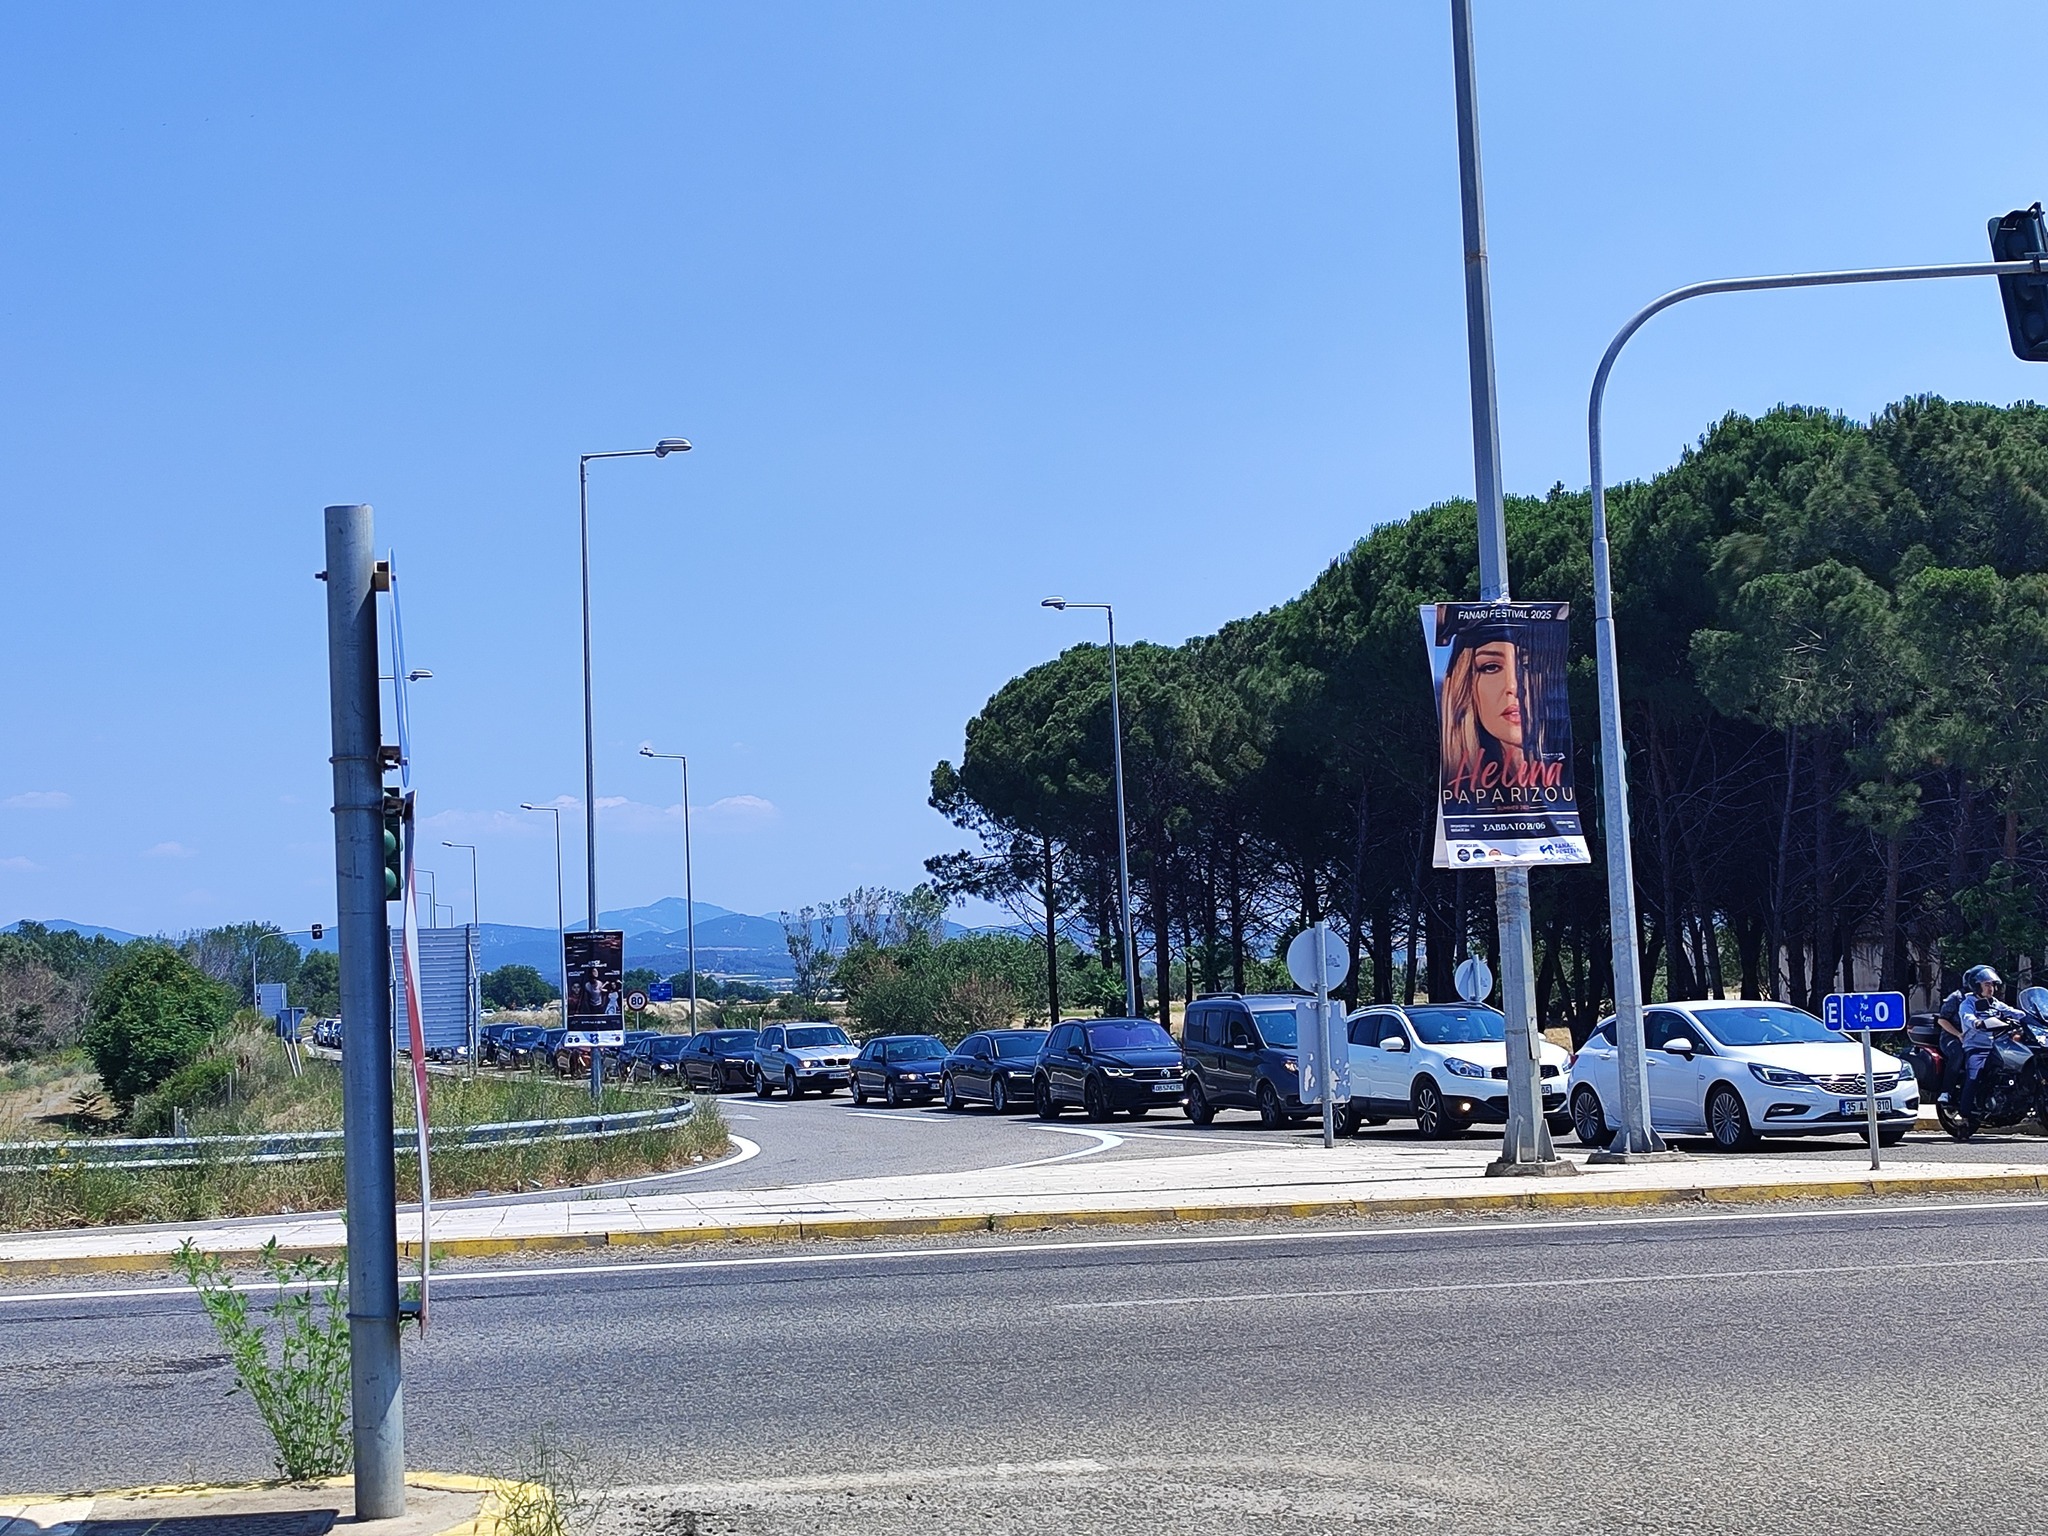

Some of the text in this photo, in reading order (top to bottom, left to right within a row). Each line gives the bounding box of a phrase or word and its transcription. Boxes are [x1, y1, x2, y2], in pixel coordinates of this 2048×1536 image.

[1458, 608, 1552, 620] FANARI FESTIVAL 2025
[1442, 786, 1573, 805] PAPARIZOU
[631, 996, 643, 1006] 80
[1828, 1002, 1838, 1024] E
[1874, 1001, 1889, 1022] 0
[1877, 1101, 1890, 1111] 810
